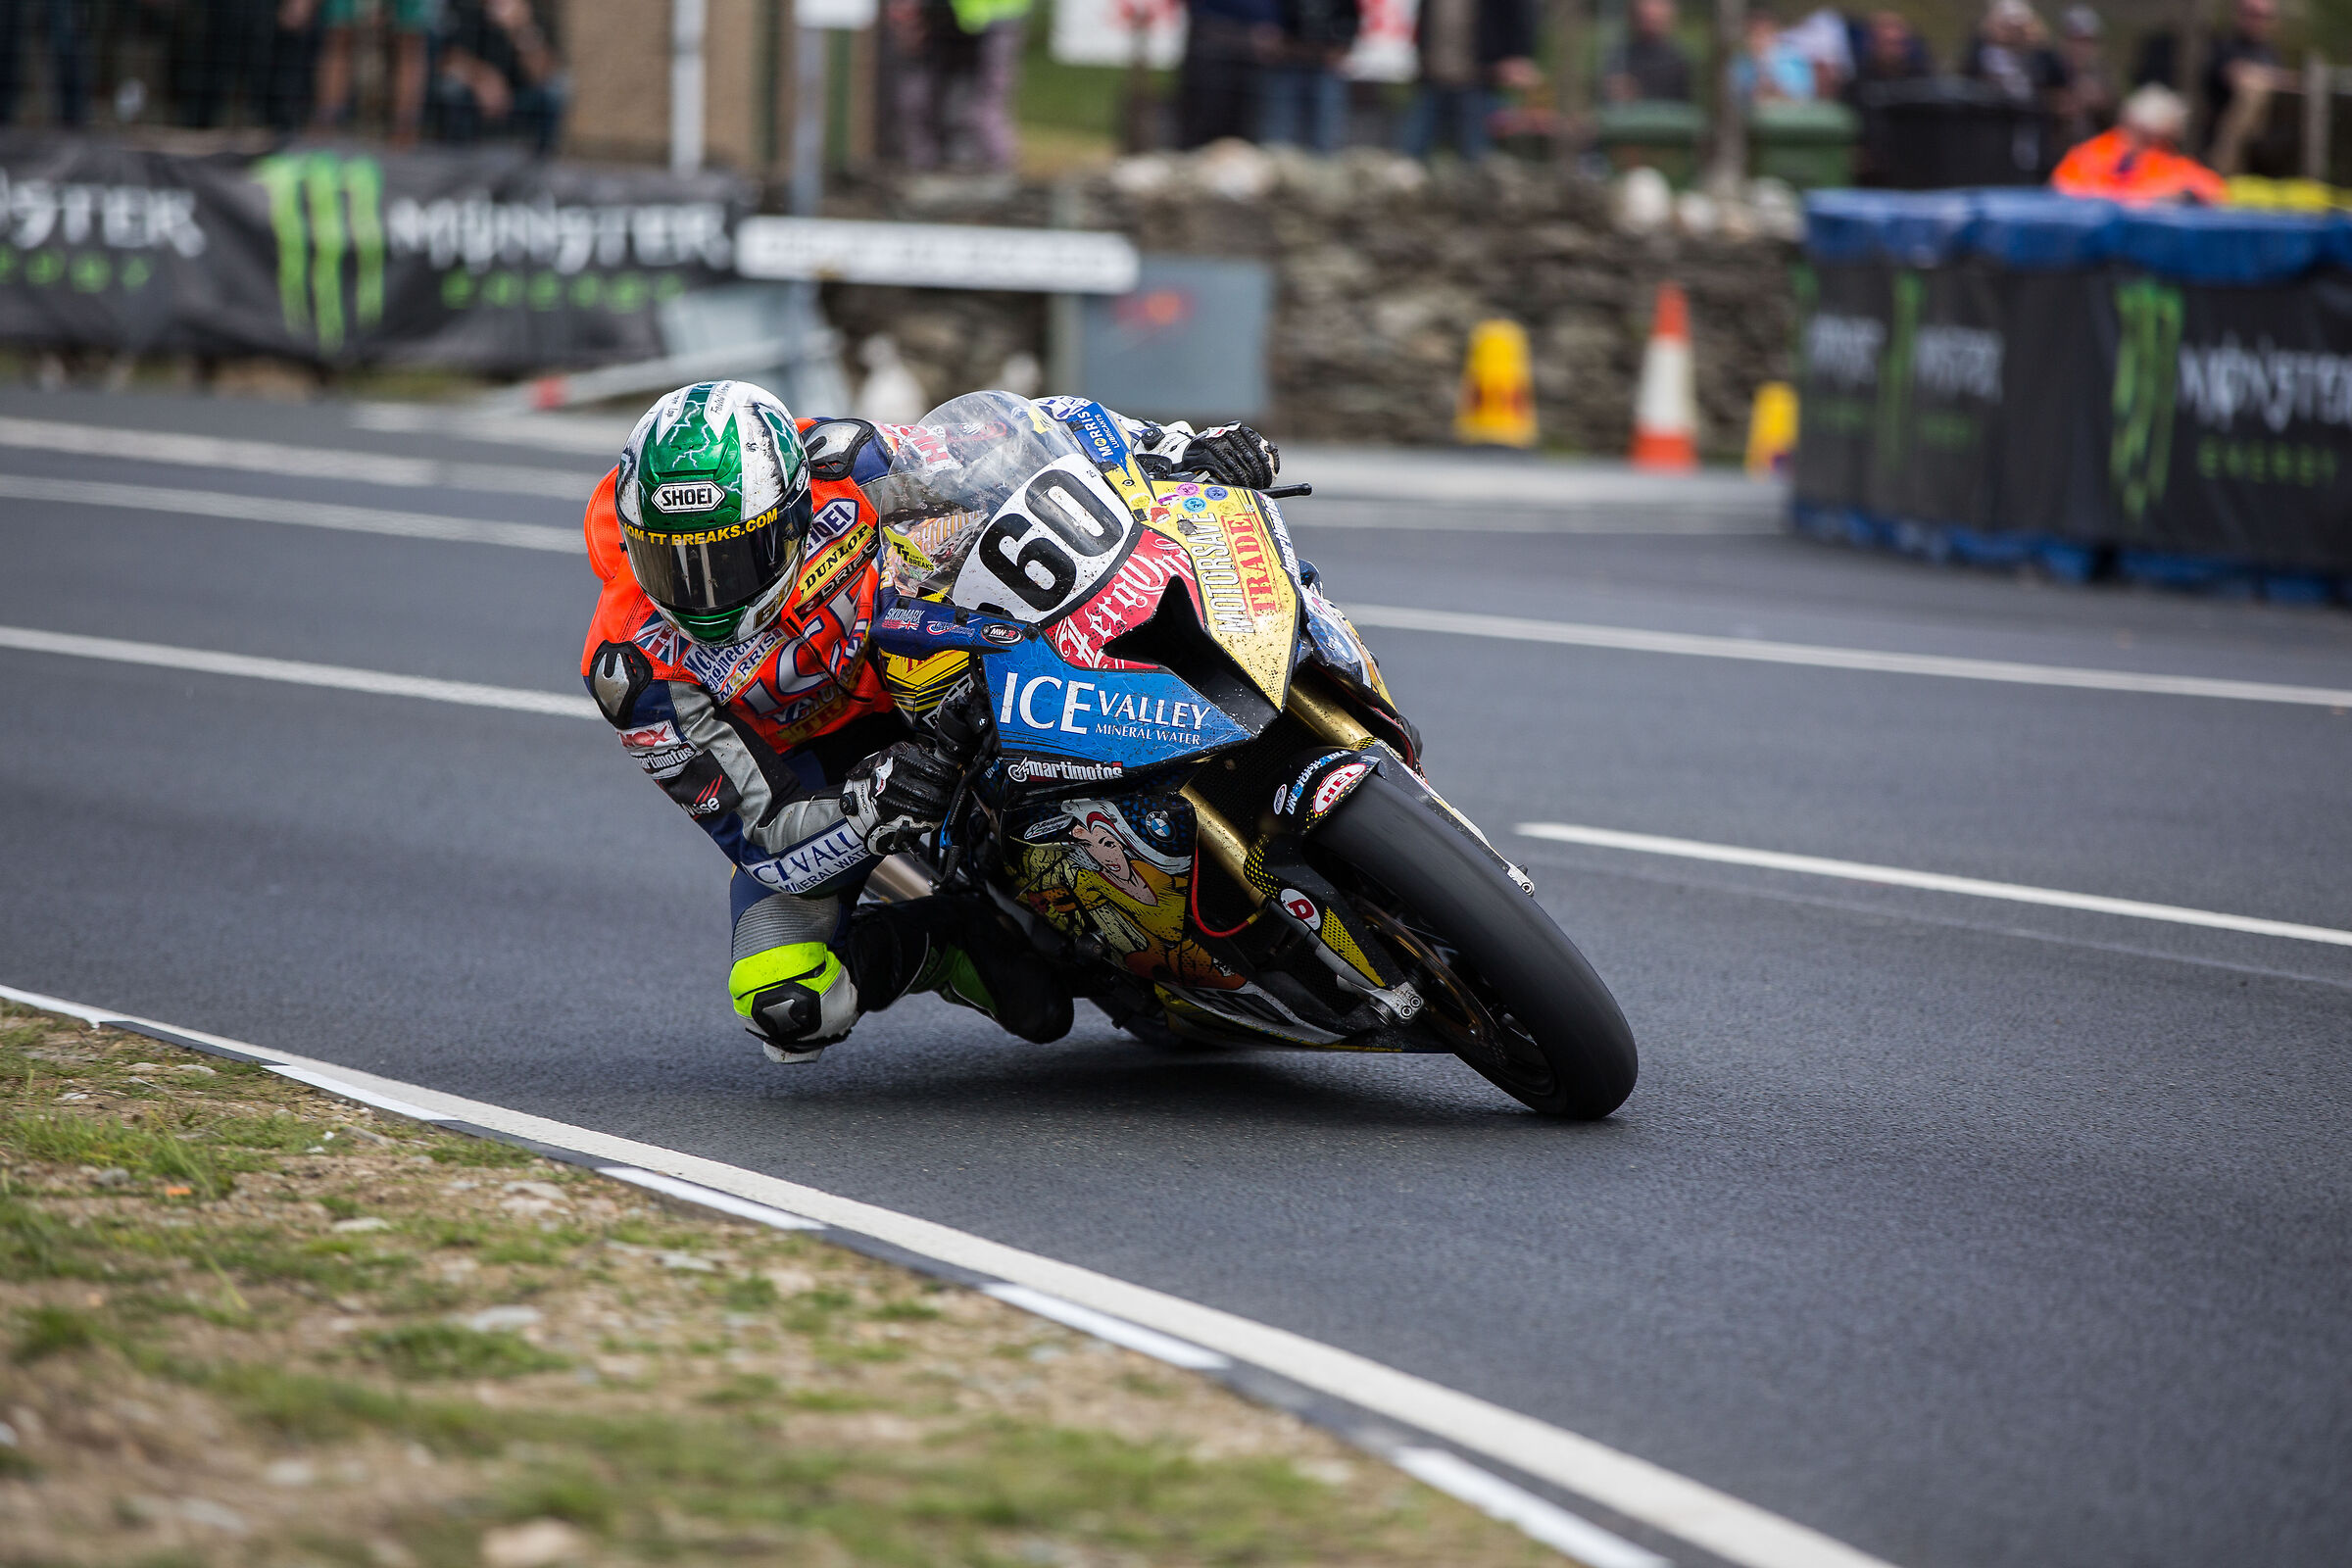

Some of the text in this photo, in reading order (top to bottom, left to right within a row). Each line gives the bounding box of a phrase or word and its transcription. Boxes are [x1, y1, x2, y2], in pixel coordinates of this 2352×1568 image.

[0, 172, 205, 258] STER
[662, 488, 712, 507] SHOEI
[647, 532, 667, 545] TT
[671, 508, 778, 546] BREAKS.COM
[808, 505, 853, 550] HOEI
[980, 469, 1124, 612] 60
[805, 524, 869, 590] DUNLOP
[1227, 516, 1278, 617] TRADE
[999, 671, 1211, 735] ICE VALLEY
[1095, 722, 1200, 746] MINERAL WATER
[640, 747, 696, 769] artimotos
[1026, 760, 1124, 781] martimotos
[790, 831, 862, 873] VALL
[834, 847, 870, 870] WATE
